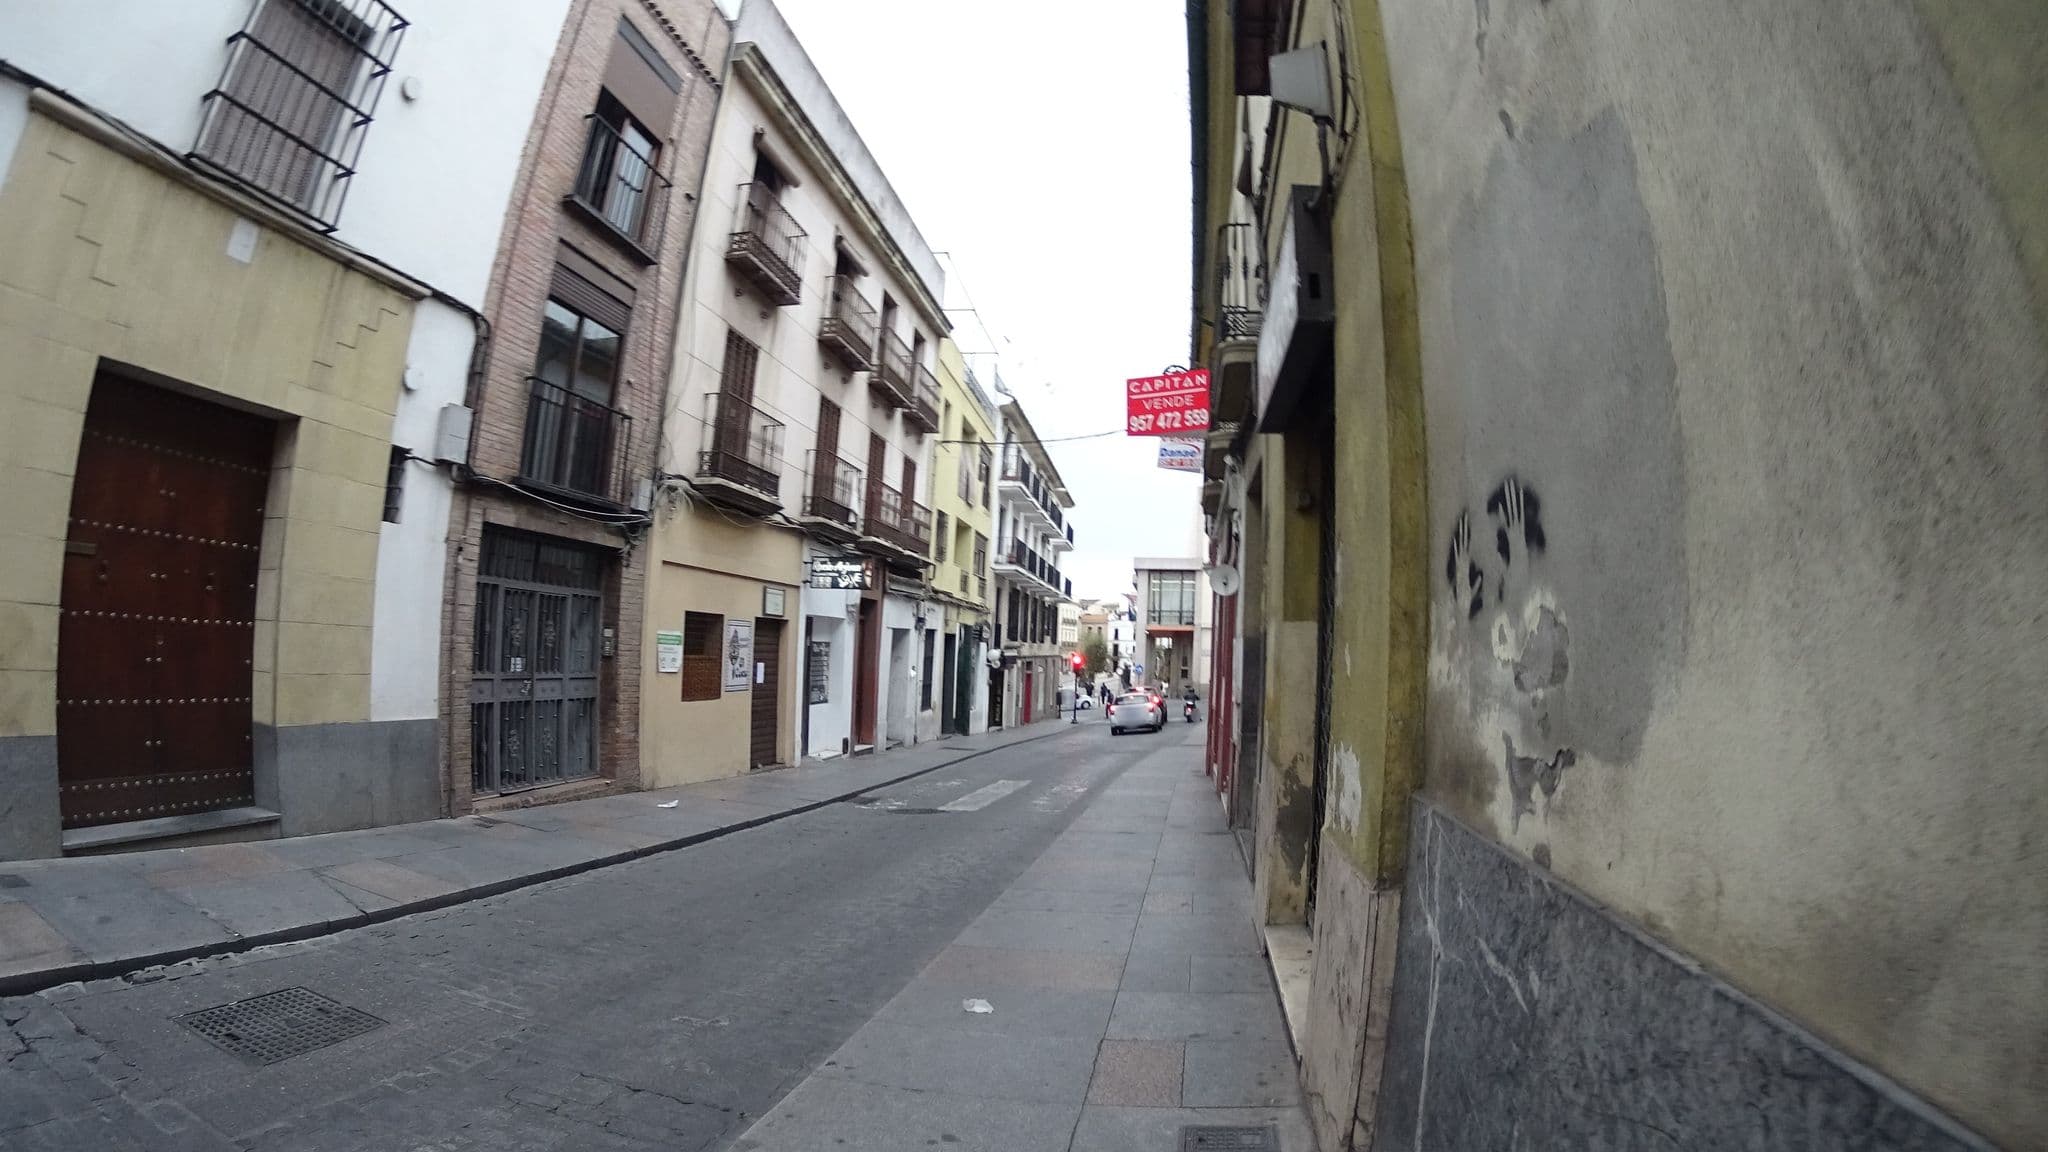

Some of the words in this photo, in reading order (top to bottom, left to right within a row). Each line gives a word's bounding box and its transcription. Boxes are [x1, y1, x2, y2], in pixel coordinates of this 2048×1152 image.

[1129, 375, 1207, 393] CAPITAN
[1142, 394, 1193, 410] VENDE
[1130, 414, 1154, 432] 957
[1157, 412, 1182, 429] 472
